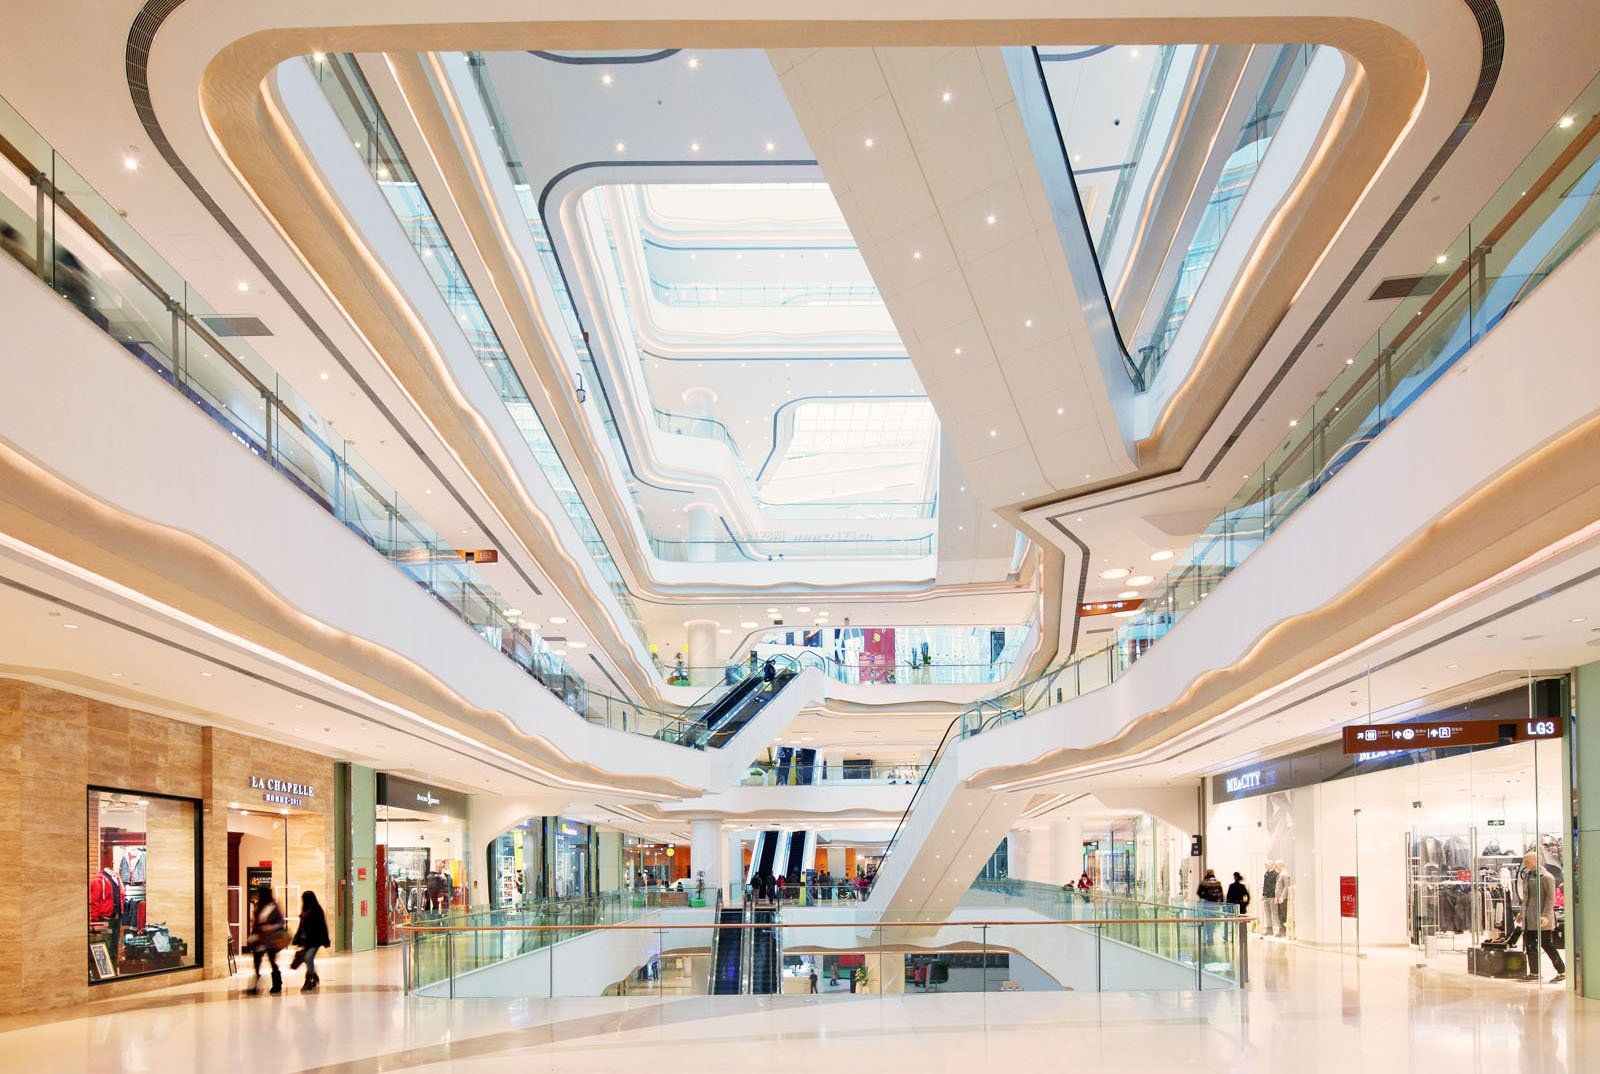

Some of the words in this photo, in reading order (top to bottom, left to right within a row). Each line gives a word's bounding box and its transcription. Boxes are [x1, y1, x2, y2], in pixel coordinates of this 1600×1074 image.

[1527, 721, 1555, 735] LG3
[251, 776, 265, 789] LA
[267, 778, 314, 797] CHAPELLE
[1226, 770, 1261, 793] ME&CITY
